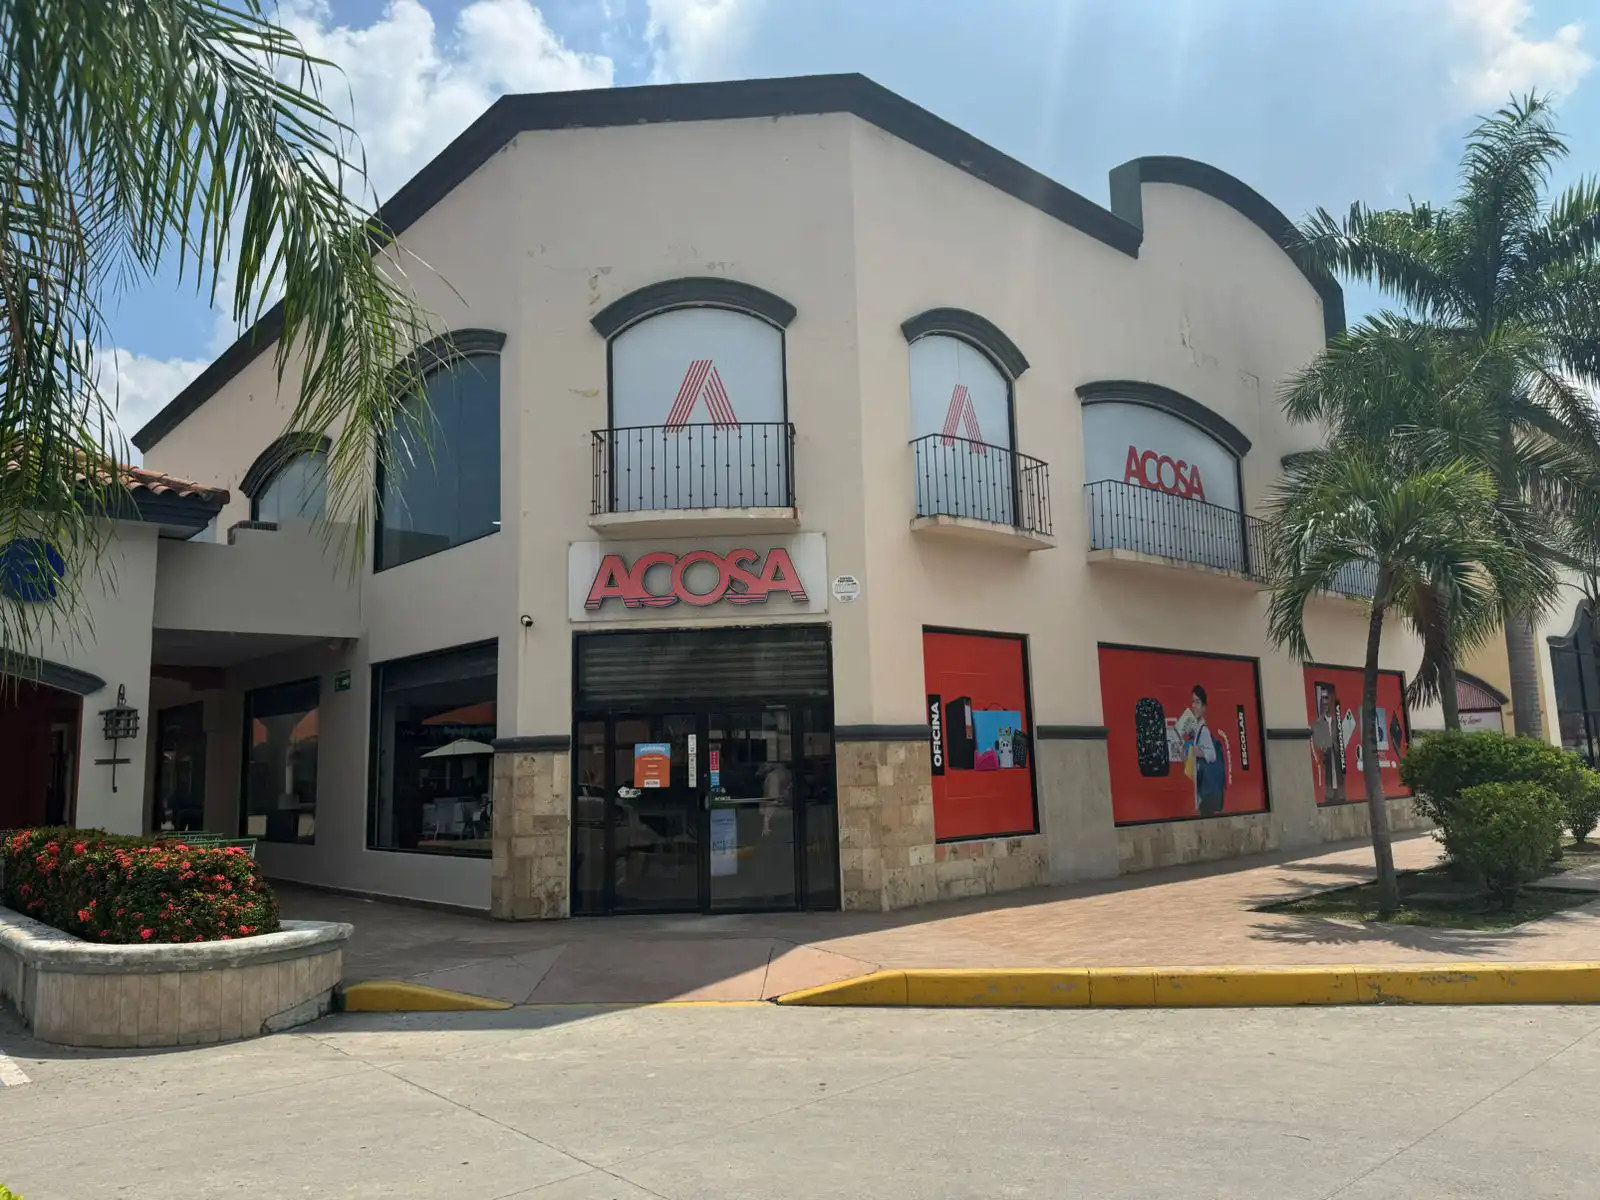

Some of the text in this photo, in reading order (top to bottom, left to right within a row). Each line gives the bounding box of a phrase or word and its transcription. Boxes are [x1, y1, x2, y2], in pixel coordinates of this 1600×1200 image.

[1124, 445, 1206, 502] ACOSA
[584, 547, 809, 610] ACOSA
[930, 702, 943, 767] OFICINA
[1238, 711, 1248, 766] ESCOLAR
